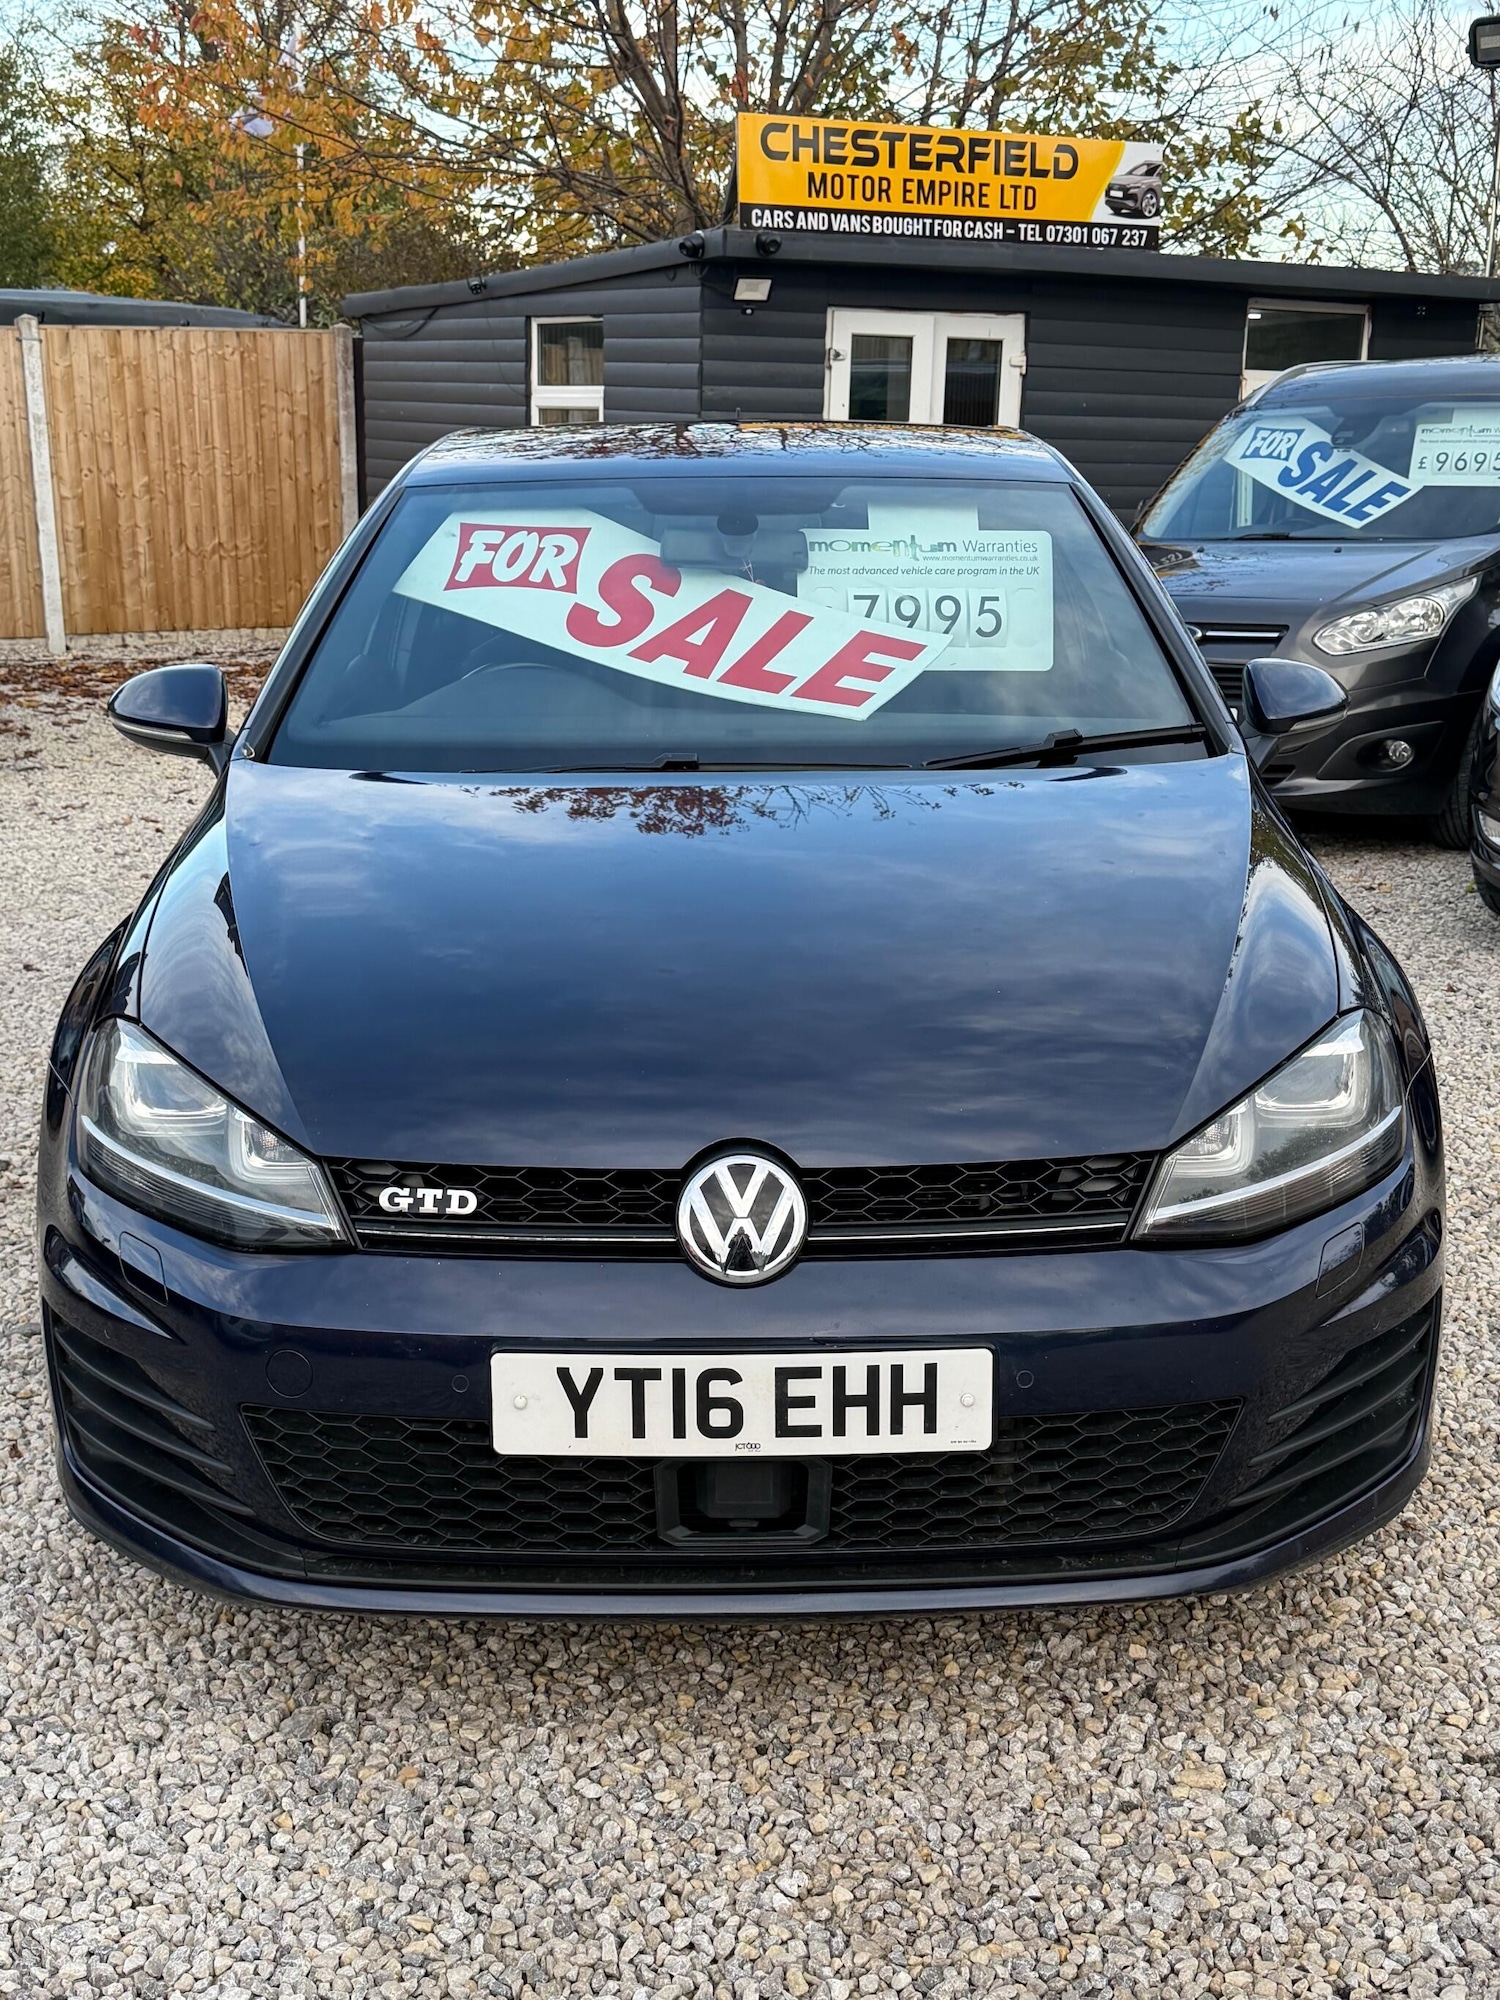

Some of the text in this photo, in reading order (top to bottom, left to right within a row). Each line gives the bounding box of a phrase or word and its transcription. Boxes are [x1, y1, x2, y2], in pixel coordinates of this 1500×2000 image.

[760, 122, 1079, 180] CHESTERFIELD
[807, 171, 1037, 211] MOTOR EMPIRE LTD
[751, 208, 794, 229] CARS
[796, 211, 829, 231] AND
[829, 213, 871, 233] VANS
[873, 215, 933, 237] BOUGHT
[933, 219, 963, 239] FOR
[964, 221, 1004, 240] CASH
[1018, 223, 1044, 242] TEL
[1046, 225, 1088, 244] 07301
[1091, 227, 1118, 246] 067
[1121, 229, 1148, 247] 237
[1244, 429, 1412, 522] FOR SALE
[808, 534, 1038, 562] momentum Warranties
[809, 566, 1040, 578] The most advanced vehicle care program in the UK
[451, 529, 928, 708] FOR SALE
[853, 594, 1003, 638] 7995
[377, 1186, 479, 1216] GTD
[556, 1362, 939, 1440] YT16 EHH
